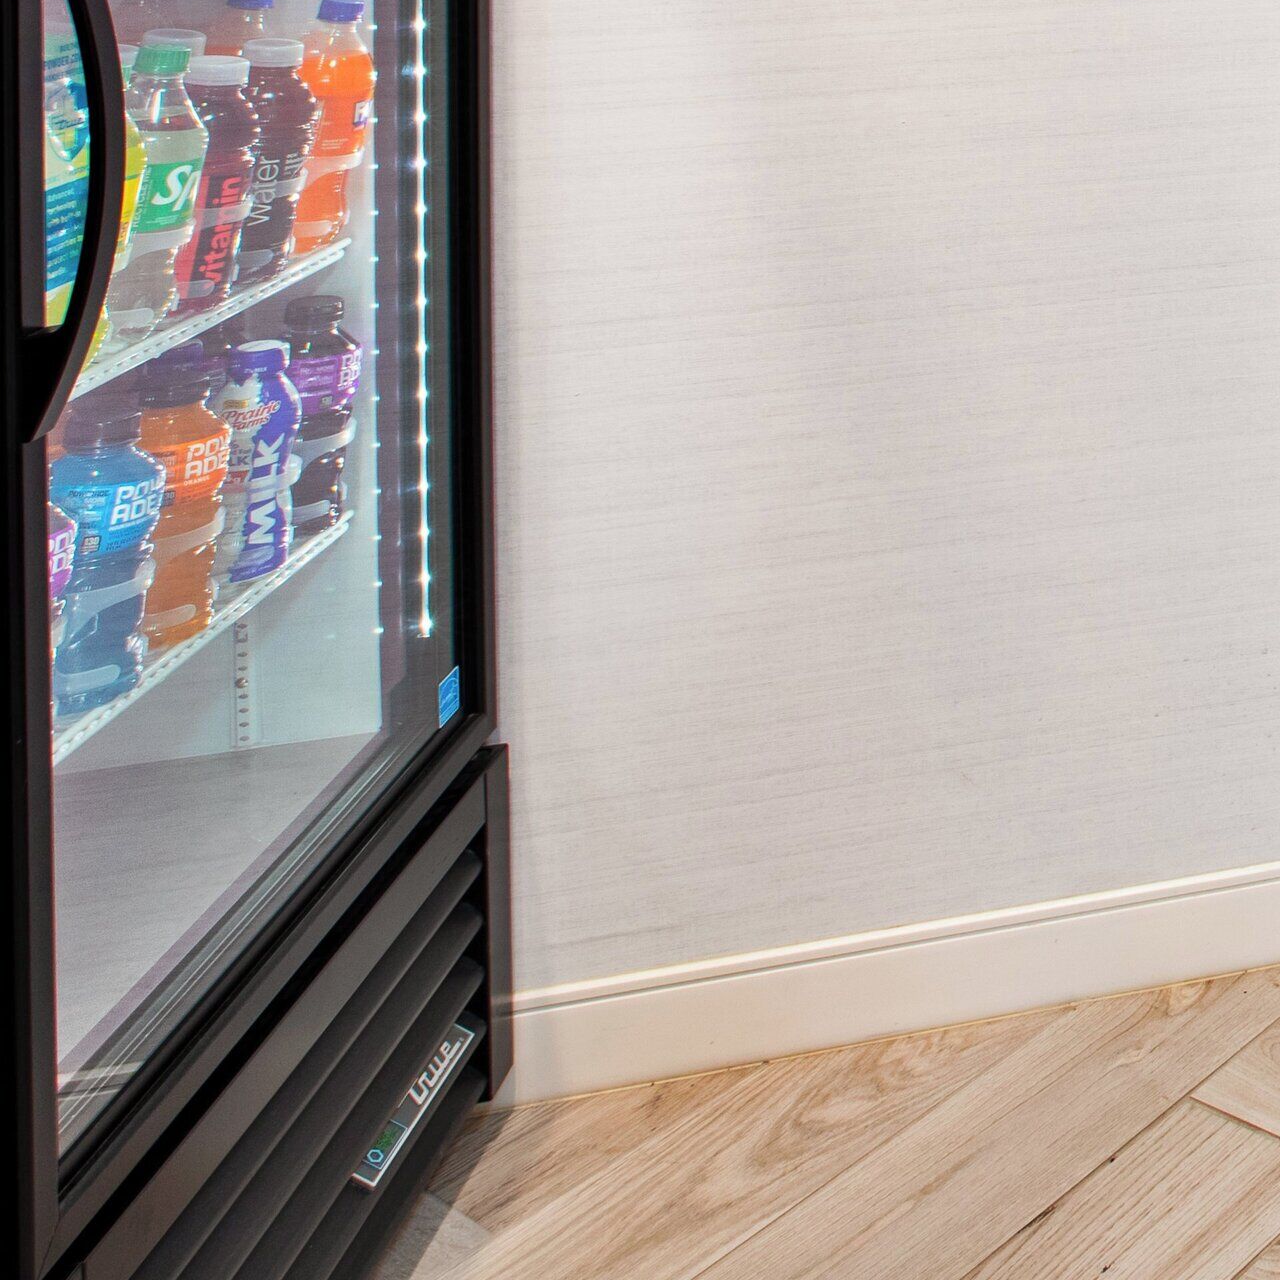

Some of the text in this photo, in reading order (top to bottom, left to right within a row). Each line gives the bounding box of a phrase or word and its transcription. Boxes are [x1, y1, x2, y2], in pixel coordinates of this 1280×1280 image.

[247, 158, 281, 227] water
[200, 176, 242, 289] vitamin
[222, 400, 282, 423] Prairie
[232, 416, 271, 432] Farms
[248, 432, 285, 545] MILK
